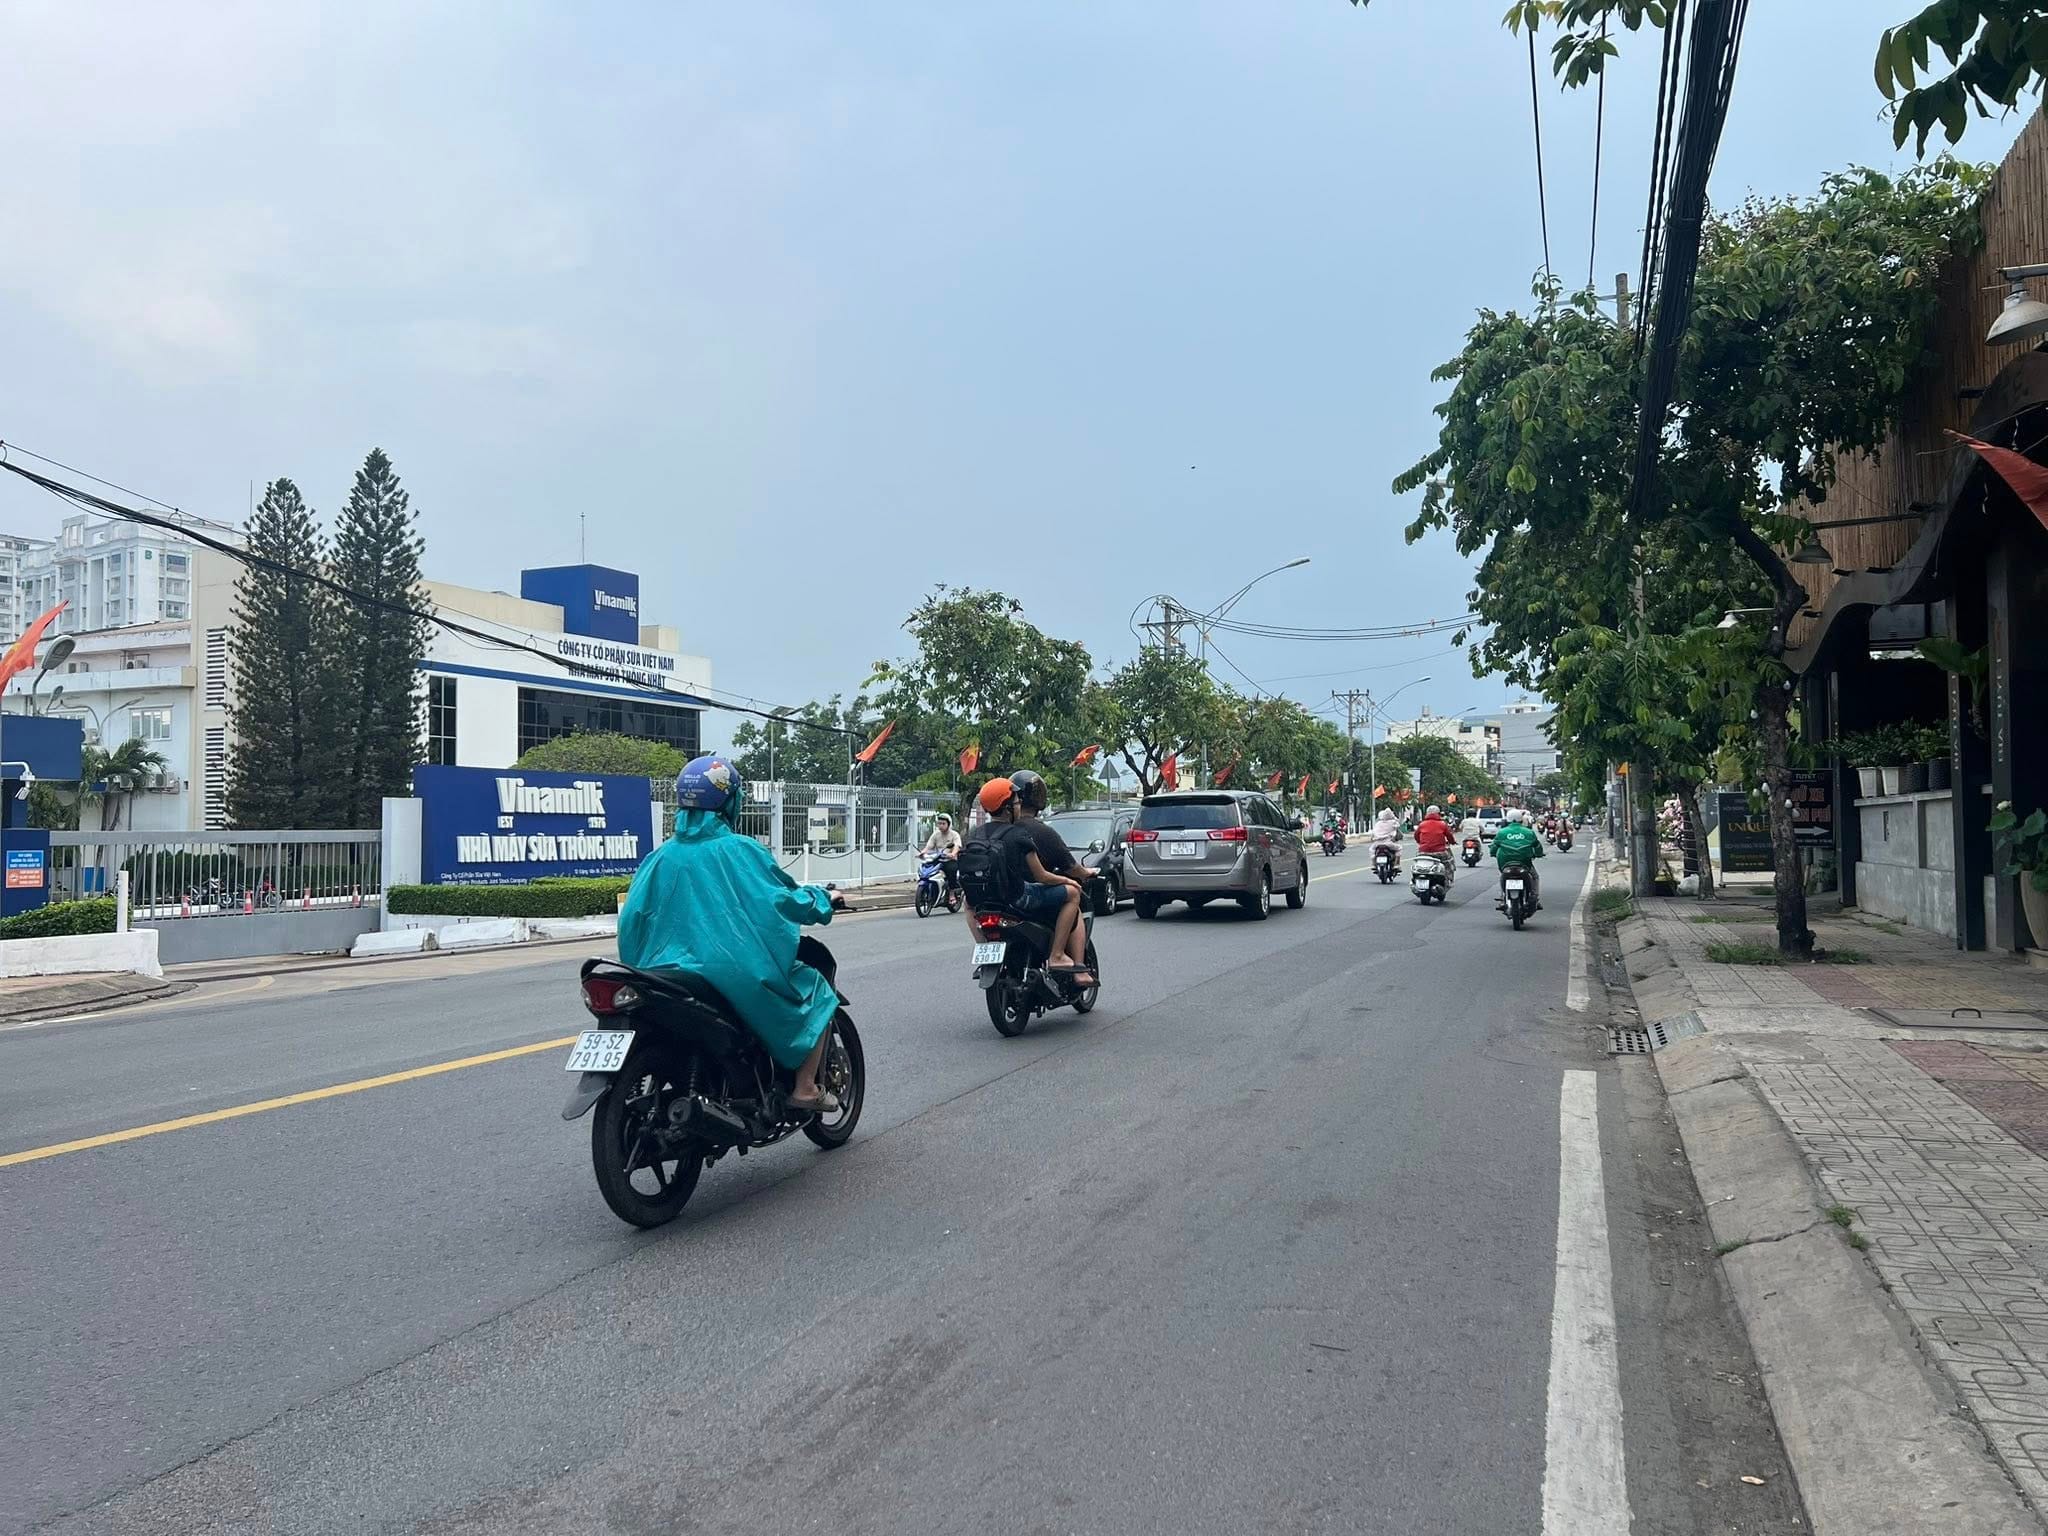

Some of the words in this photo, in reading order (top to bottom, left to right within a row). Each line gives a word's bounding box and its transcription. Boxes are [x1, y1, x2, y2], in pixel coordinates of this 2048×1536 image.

[595, 590, 636, 611] Vinamilk
[557, 639, 579, 658] CÔNG
[581, 643, 592, 658] TY
[658, 655, 675, 671] NAM
[495, 777, 606, 815] Vinamilk
[456, 832, 492, 863] NHÀ
[491, 832, 527, 862] MÁY
[557, 829, 604, 860] THỐNG
[603, 829, 639, 860] NHẤT
[584, 1034, 624, 1050] 59-S2
[571, 1051, 622, 1068] 791.95
